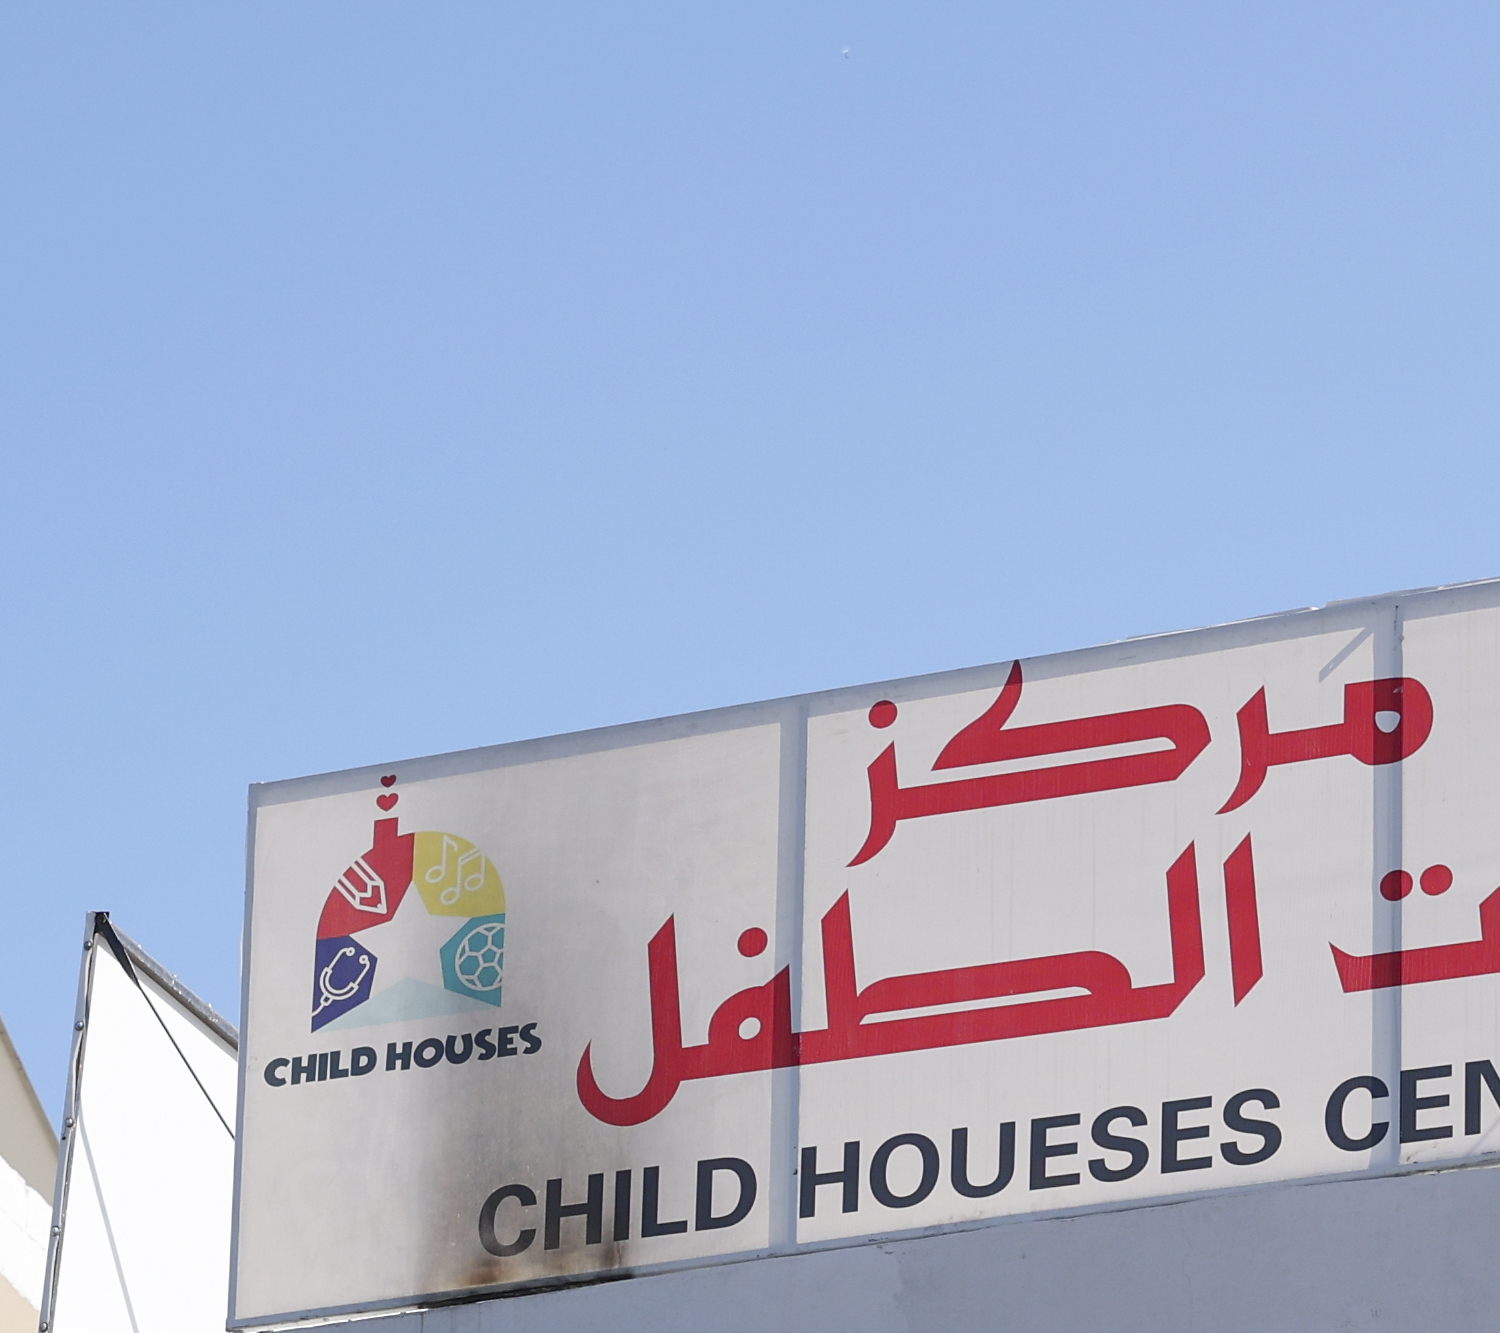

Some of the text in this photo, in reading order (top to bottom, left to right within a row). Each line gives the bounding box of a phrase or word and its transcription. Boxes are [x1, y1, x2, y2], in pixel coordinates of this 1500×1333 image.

[849, 660, 1434, 867] مركز
[263, 1022, 543, 1088] CHILD HOUSES
[577, 833, 1264, 1127] الطفل
[478, 1157, 758, 1258] CHILD
[799, 1088, 1282, 1219] HOUESES
